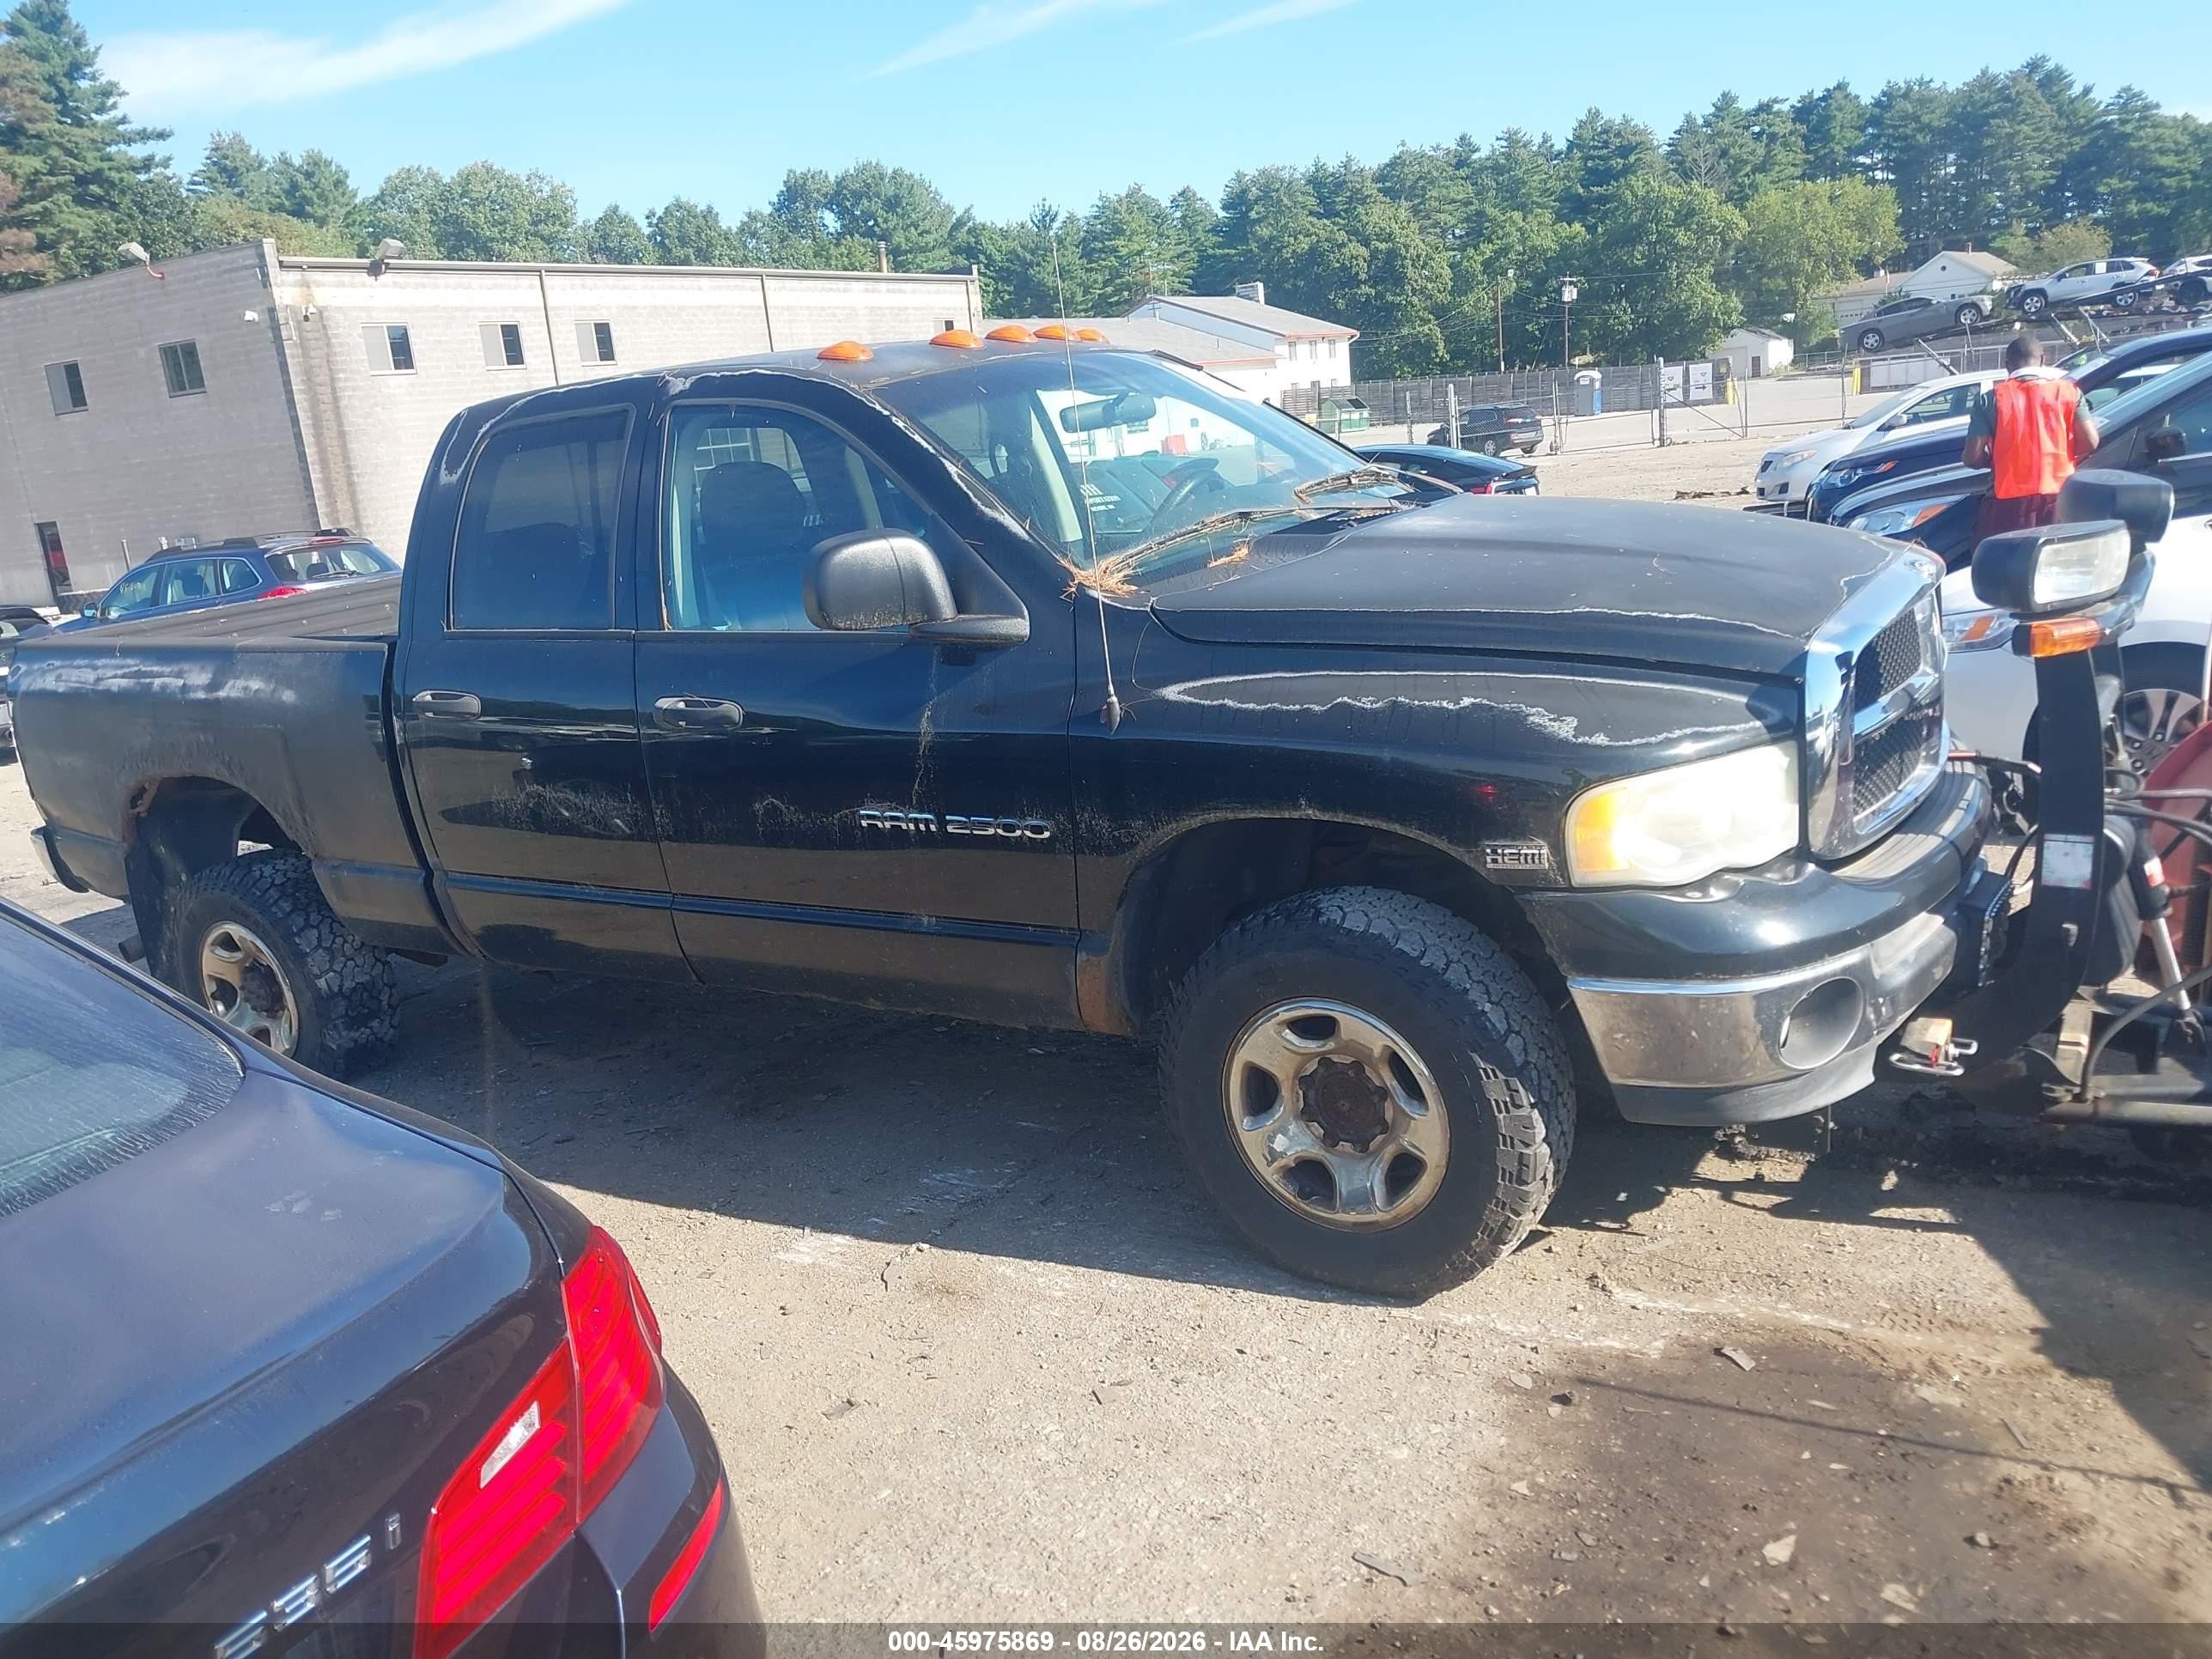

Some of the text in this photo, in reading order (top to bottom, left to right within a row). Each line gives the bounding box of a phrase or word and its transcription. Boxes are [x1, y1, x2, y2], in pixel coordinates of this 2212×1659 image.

[860, 810, 1051, 839] RAM 2500
[1485, 847, 1548, 865] HEMI
